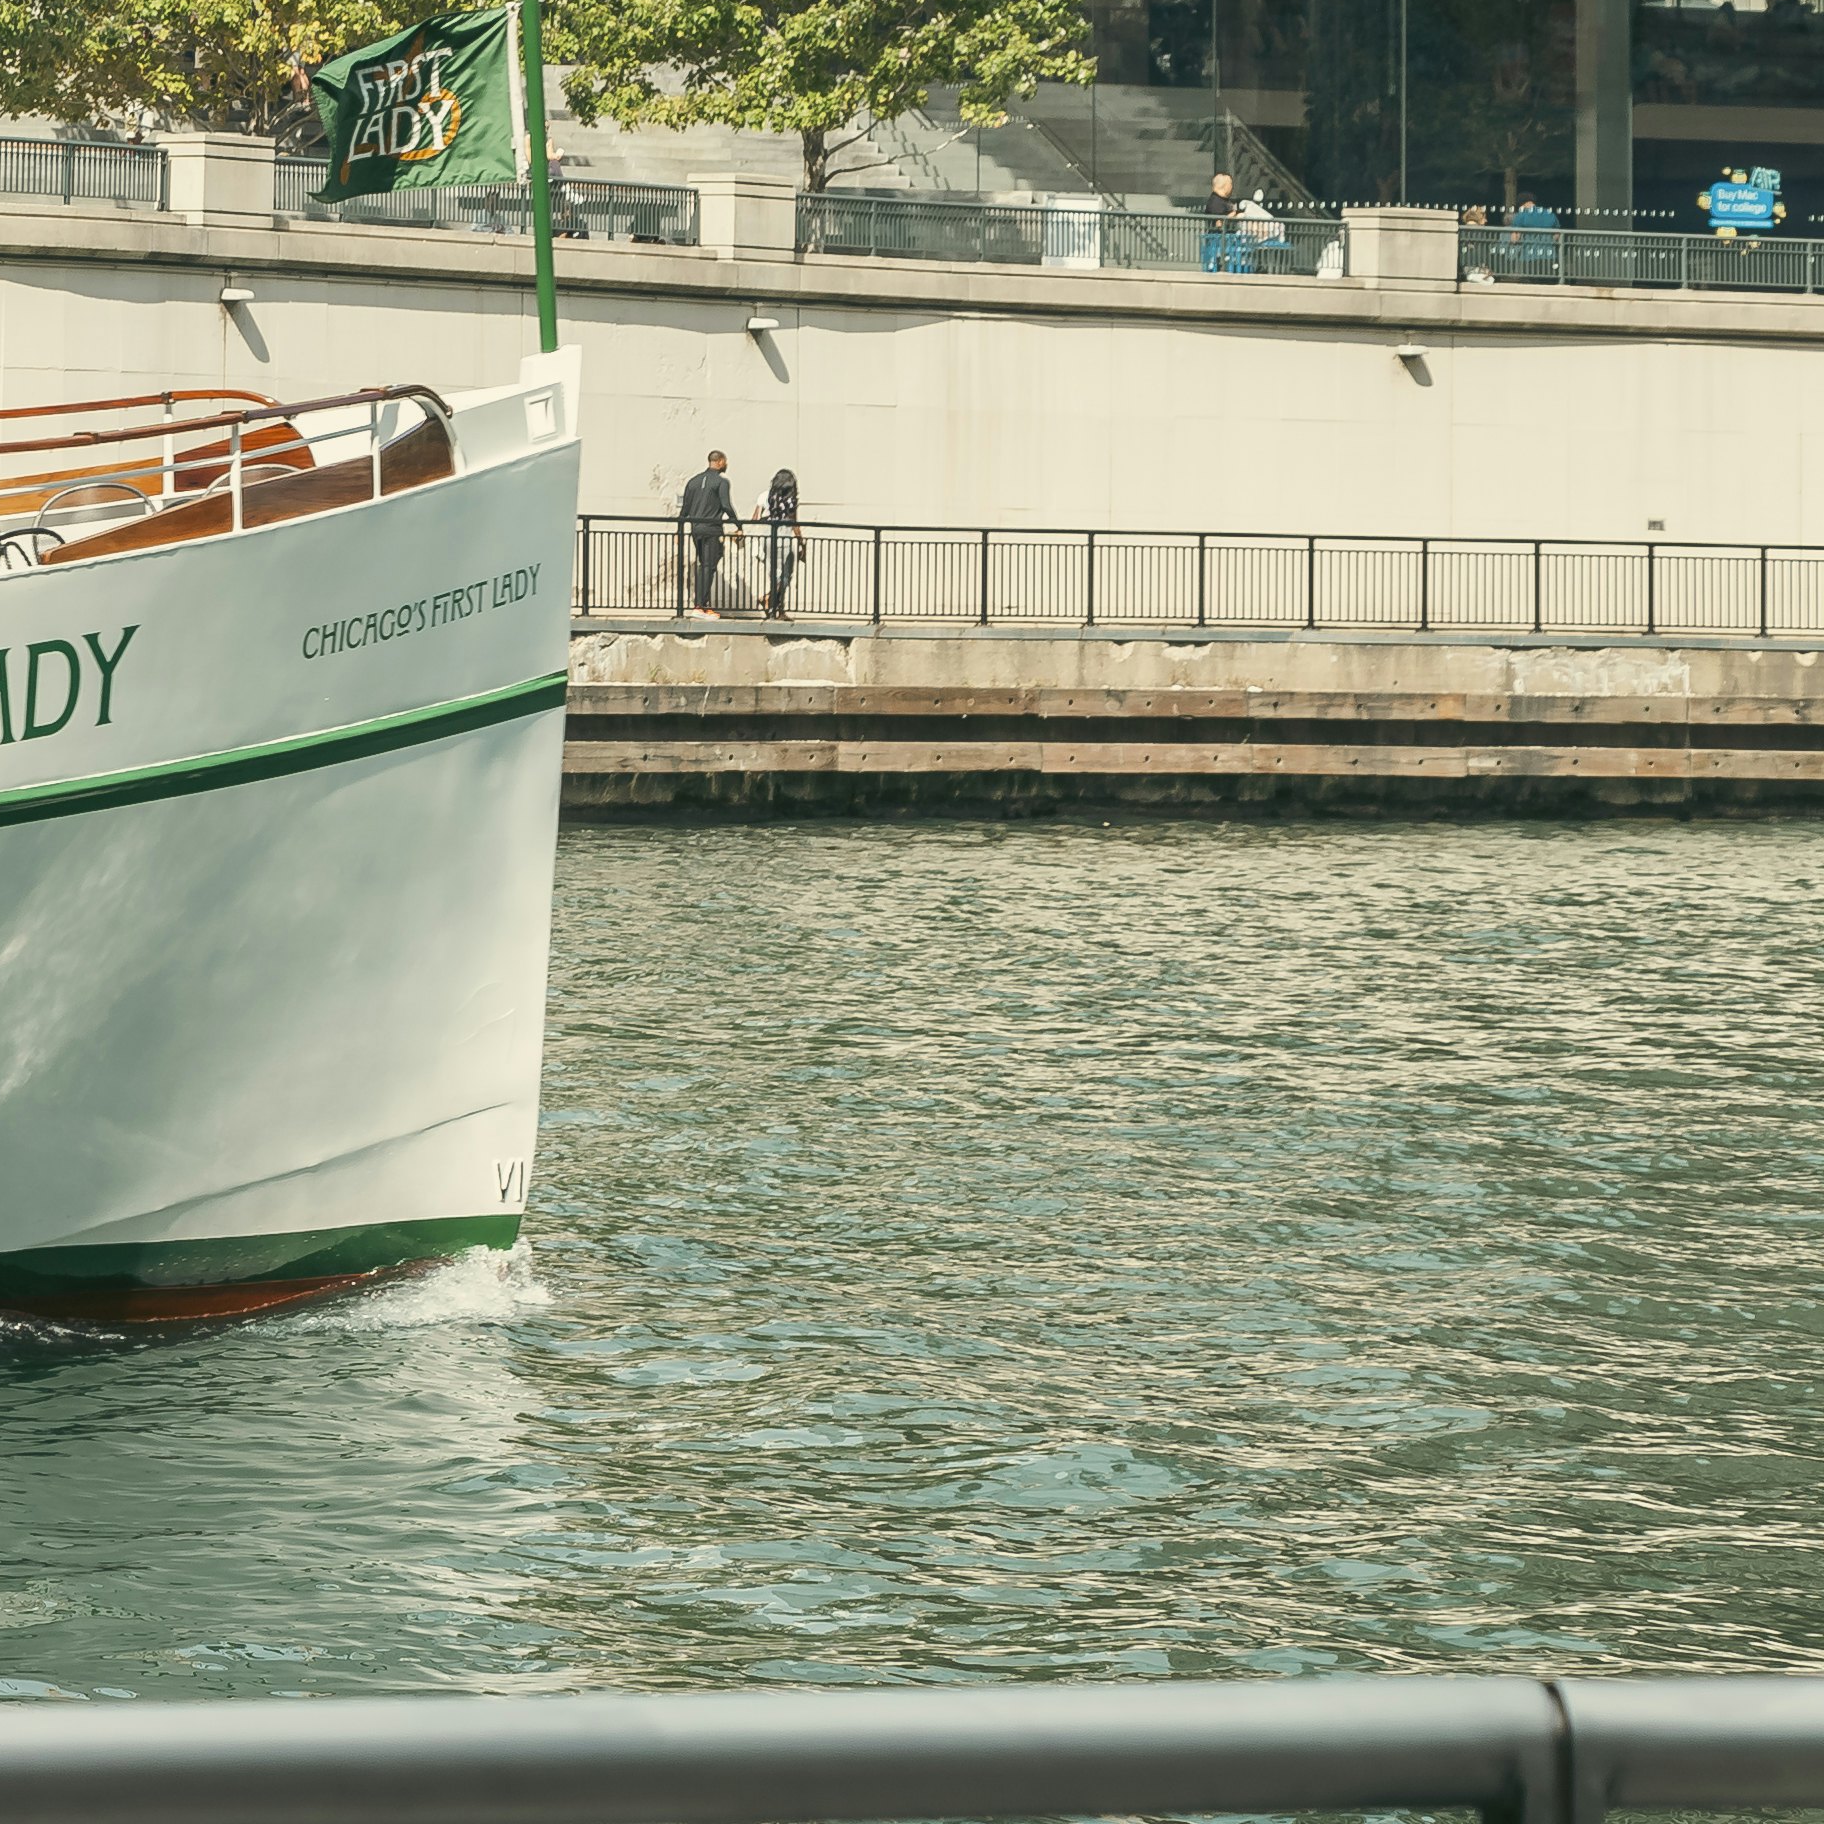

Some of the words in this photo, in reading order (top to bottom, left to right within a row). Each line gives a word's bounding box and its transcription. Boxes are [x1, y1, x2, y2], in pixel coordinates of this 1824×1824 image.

[348, 99, 456, 163] LADY
[302, 599, 427, 660] CHICAGO'S
[431, 580, 489, 628] FIRST
[492, 562, 542, 609] LADY
